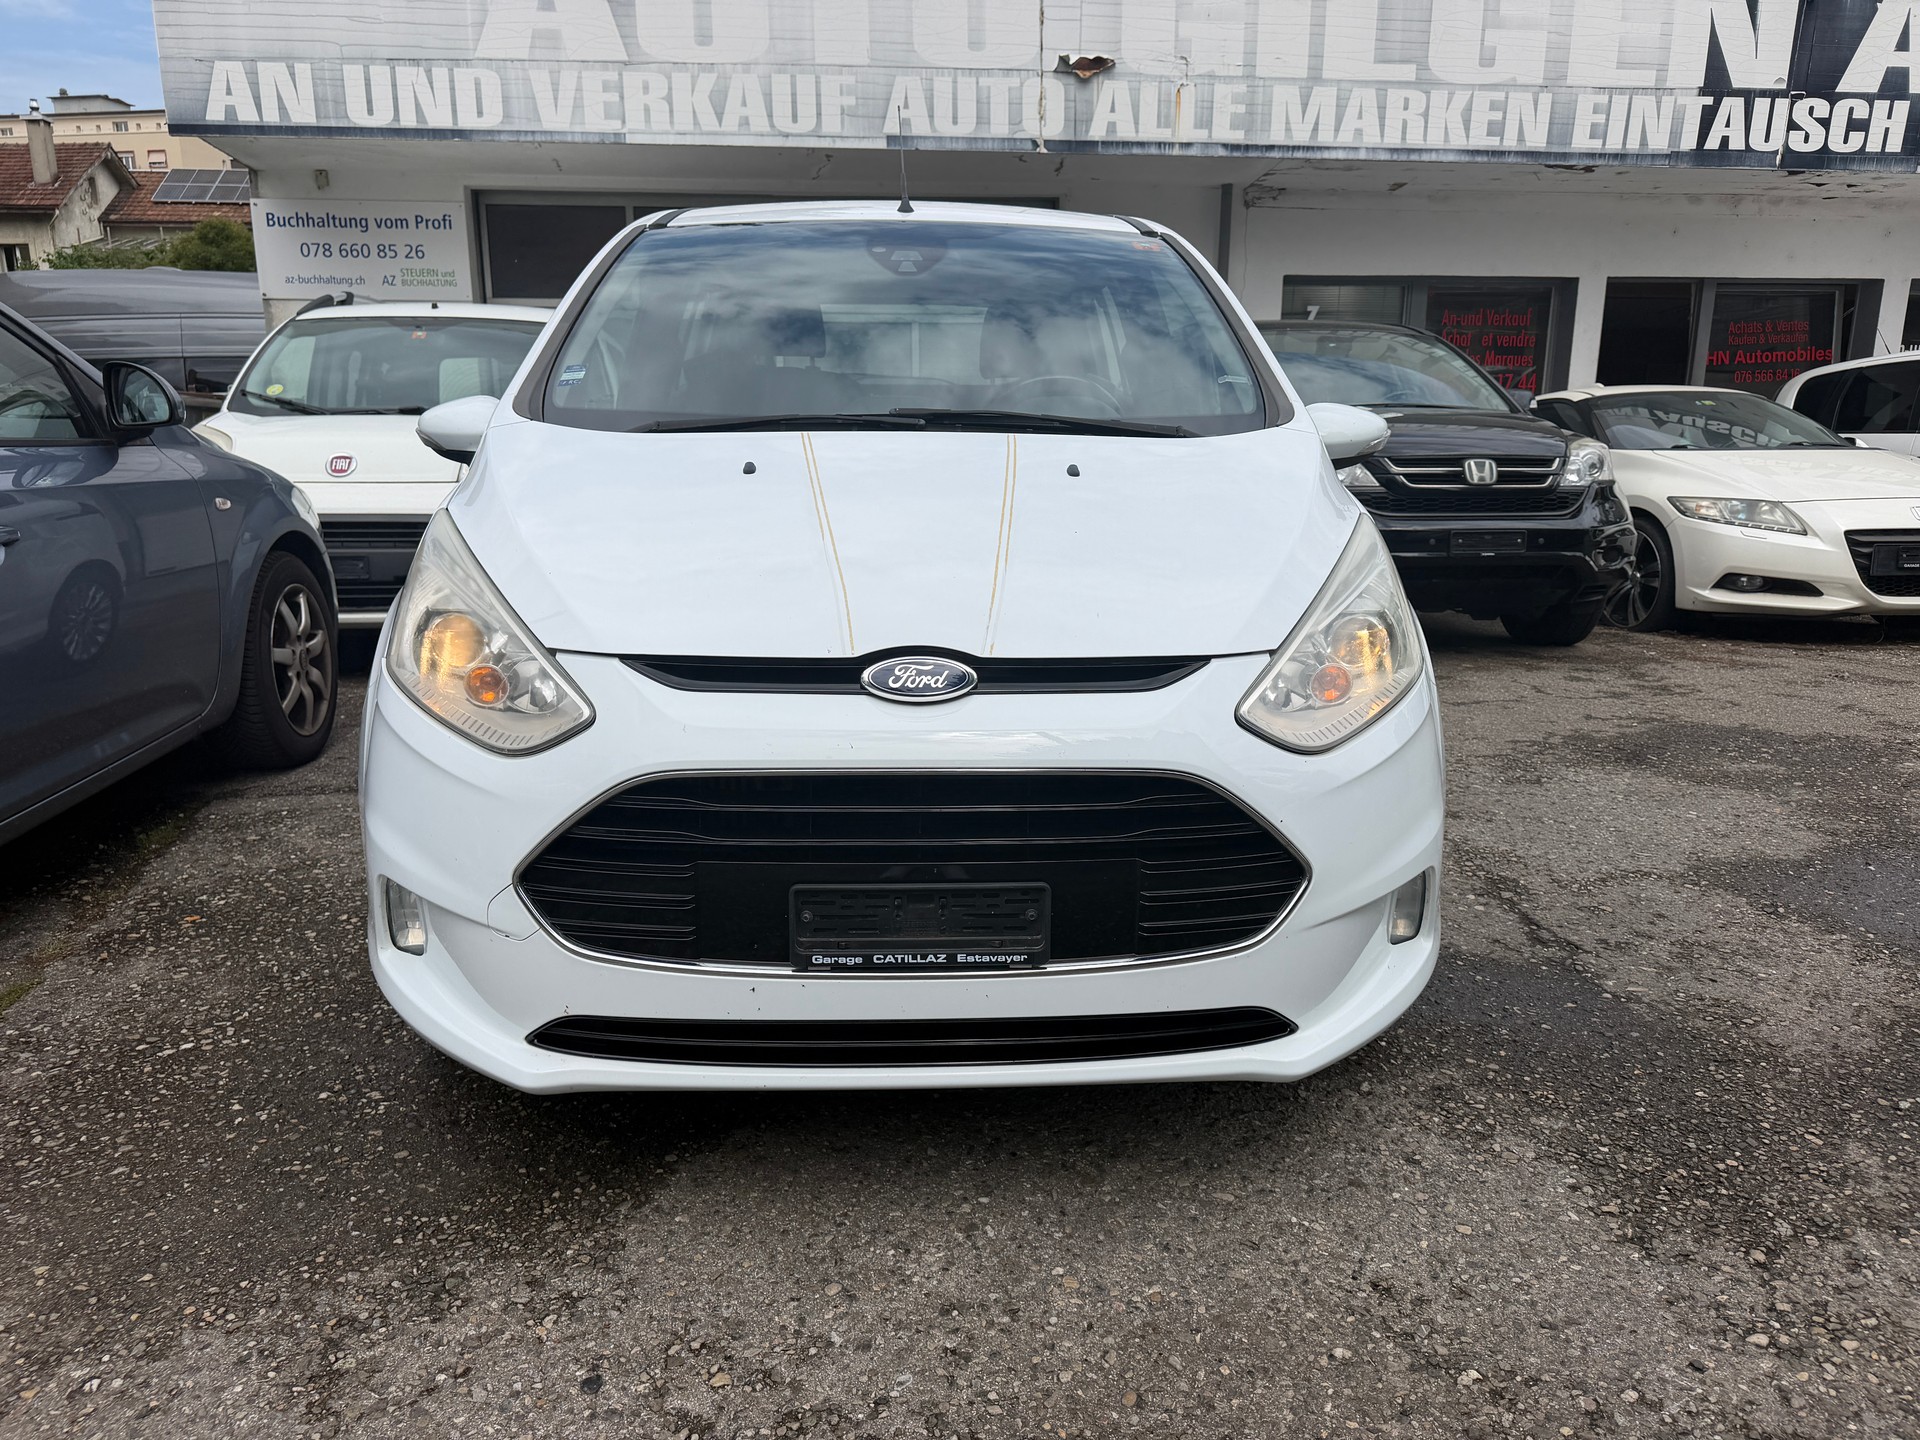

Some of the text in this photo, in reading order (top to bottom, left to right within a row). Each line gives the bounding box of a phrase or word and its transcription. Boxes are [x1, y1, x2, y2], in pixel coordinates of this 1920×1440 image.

[205, 60, 1911, 153] AN UND VERKAUF AUTO ALLE MARKEN EINTAUSCH
[266, 212, 453, 233] Buchhaltung vom Profi
[300, 243, 425, 260] 078 660 85 26
[400, 268, 455, 278] STEUERN und
[285, 274, 366, 288] az-buchhaltung.ch
[382, 275, 397, 287] AZ
[401, 278, 458, 288] BUCHHALTUNG
[1442, 308, 1533, 327] An-und Verkauf
[1728, 320, 1809, 334] Achats & Ventes
[1481, 332, 1494, 347] et
[1497, 330, 1536, 347] vendre
[1728, 332, 1809, 346] Kaufen & Verkaufen
[1484, 350, 1534, 369] Marques
[1706, 345, 1833, 366] HN Automobiles
[1734, 370, 1752, 383] 076
[1754, 369, 1774, 383] 566
[1776, 368, 1788, 381] 84
[331, 458, 350, 470] FIAT
[888, 664, 949, 688] Ford
[812, 953, 1027, 965] Garage CATILLAZ Estavayer
